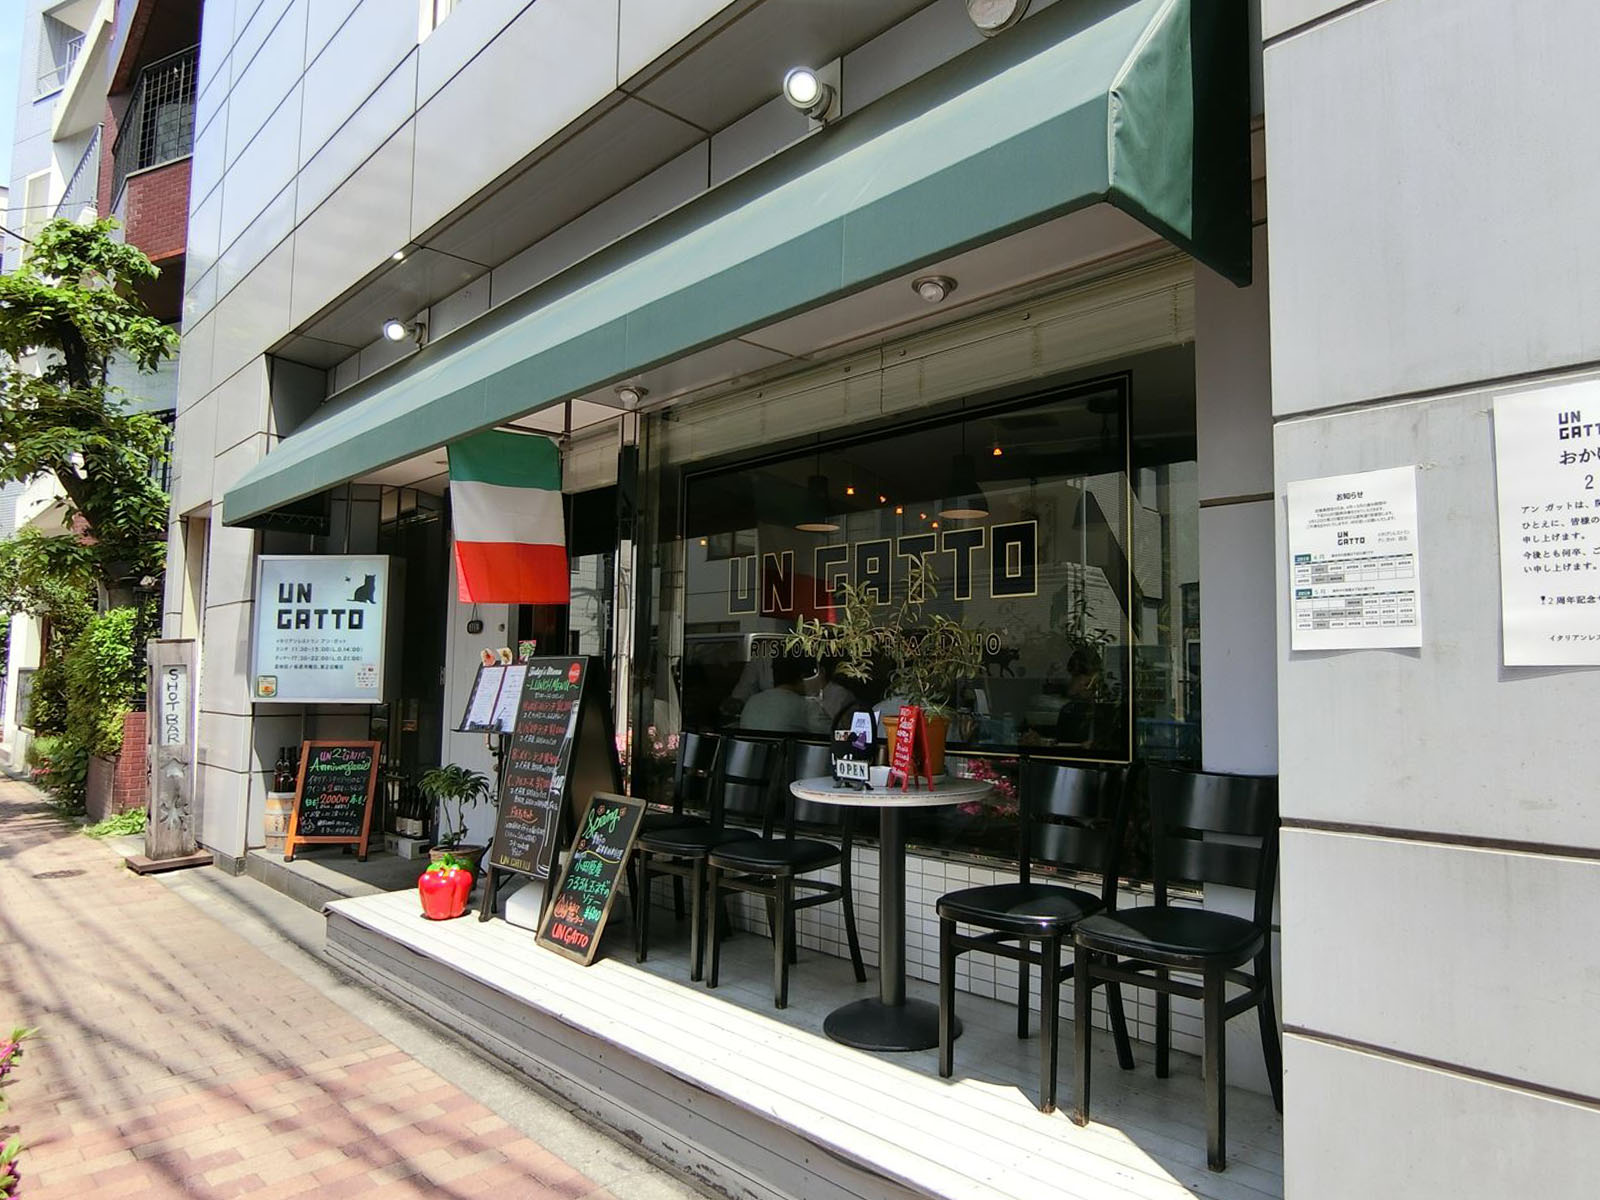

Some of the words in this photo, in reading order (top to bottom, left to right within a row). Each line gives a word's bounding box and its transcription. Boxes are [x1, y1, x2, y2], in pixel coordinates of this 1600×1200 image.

[1558, 410, 1581, 425] UN
[1559, 447, 1600, 465] おか
[1584, 474, 1594, 490] 2
[1336, 491, 1363, 501] お知らせ
[1338, 537, 1365, 545] GATTO
[1522, 532, 1585, 543] 申し上げます。
[728, 550, 794, 615] UN
[814, 520, 1038, 610] GATTO
[278, 583, 312, 603] UN
[277, 609, 364, 630] GATTO
[166, 668, 180, 711] SHOT
[166, 714, 180, 743] BAR
[839, 763, 865, 777] OPEN
